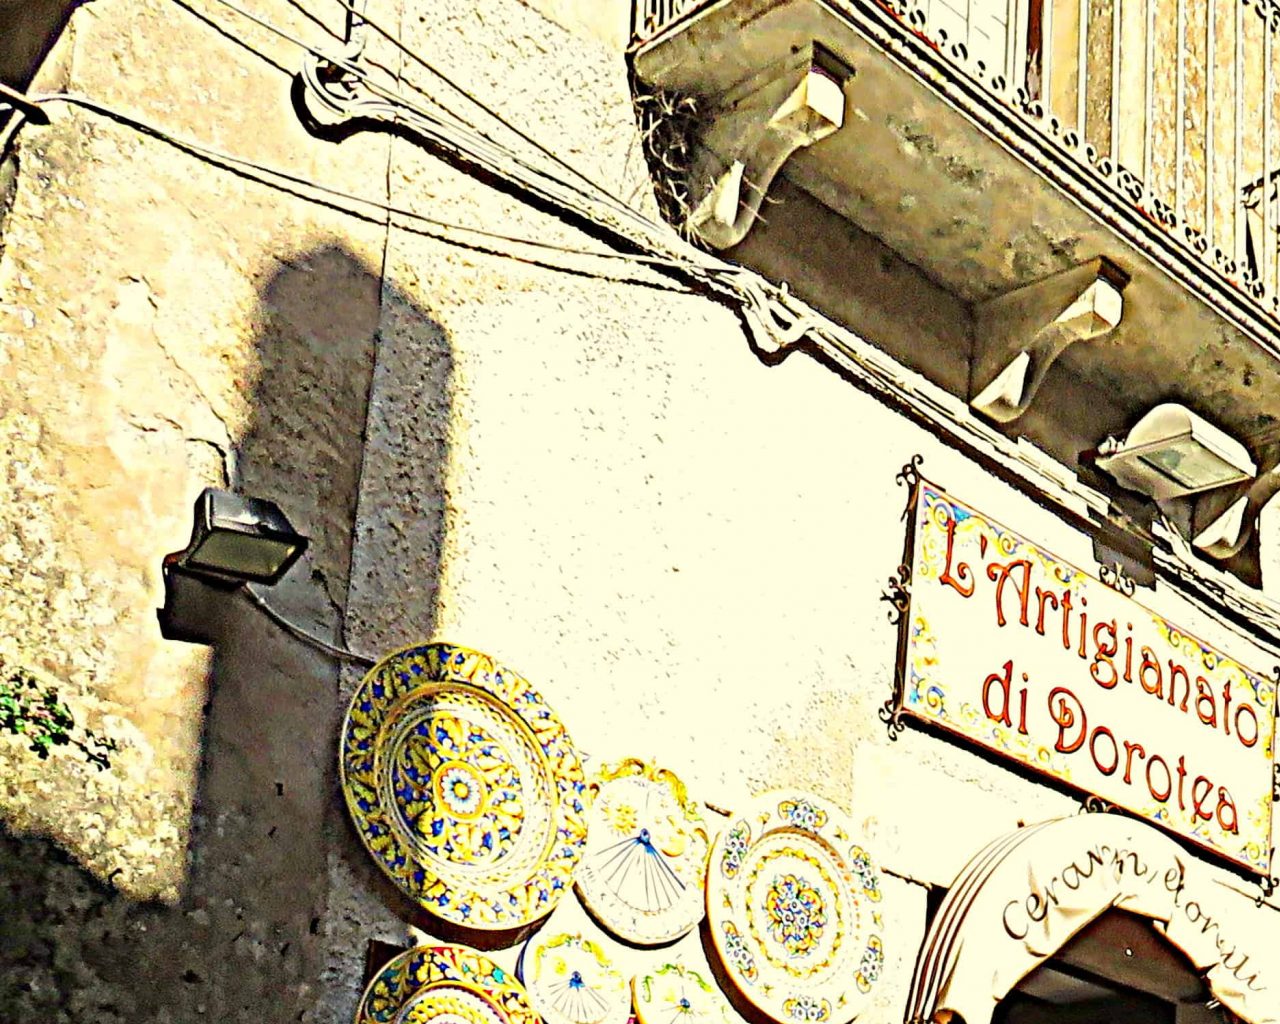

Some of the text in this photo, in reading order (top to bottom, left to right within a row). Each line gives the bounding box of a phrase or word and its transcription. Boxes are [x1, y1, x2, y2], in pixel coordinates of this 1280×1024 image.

[939, 518, 1259, 747] L'Artigianato
[983, 659, 1239, 834] di Dorotea
